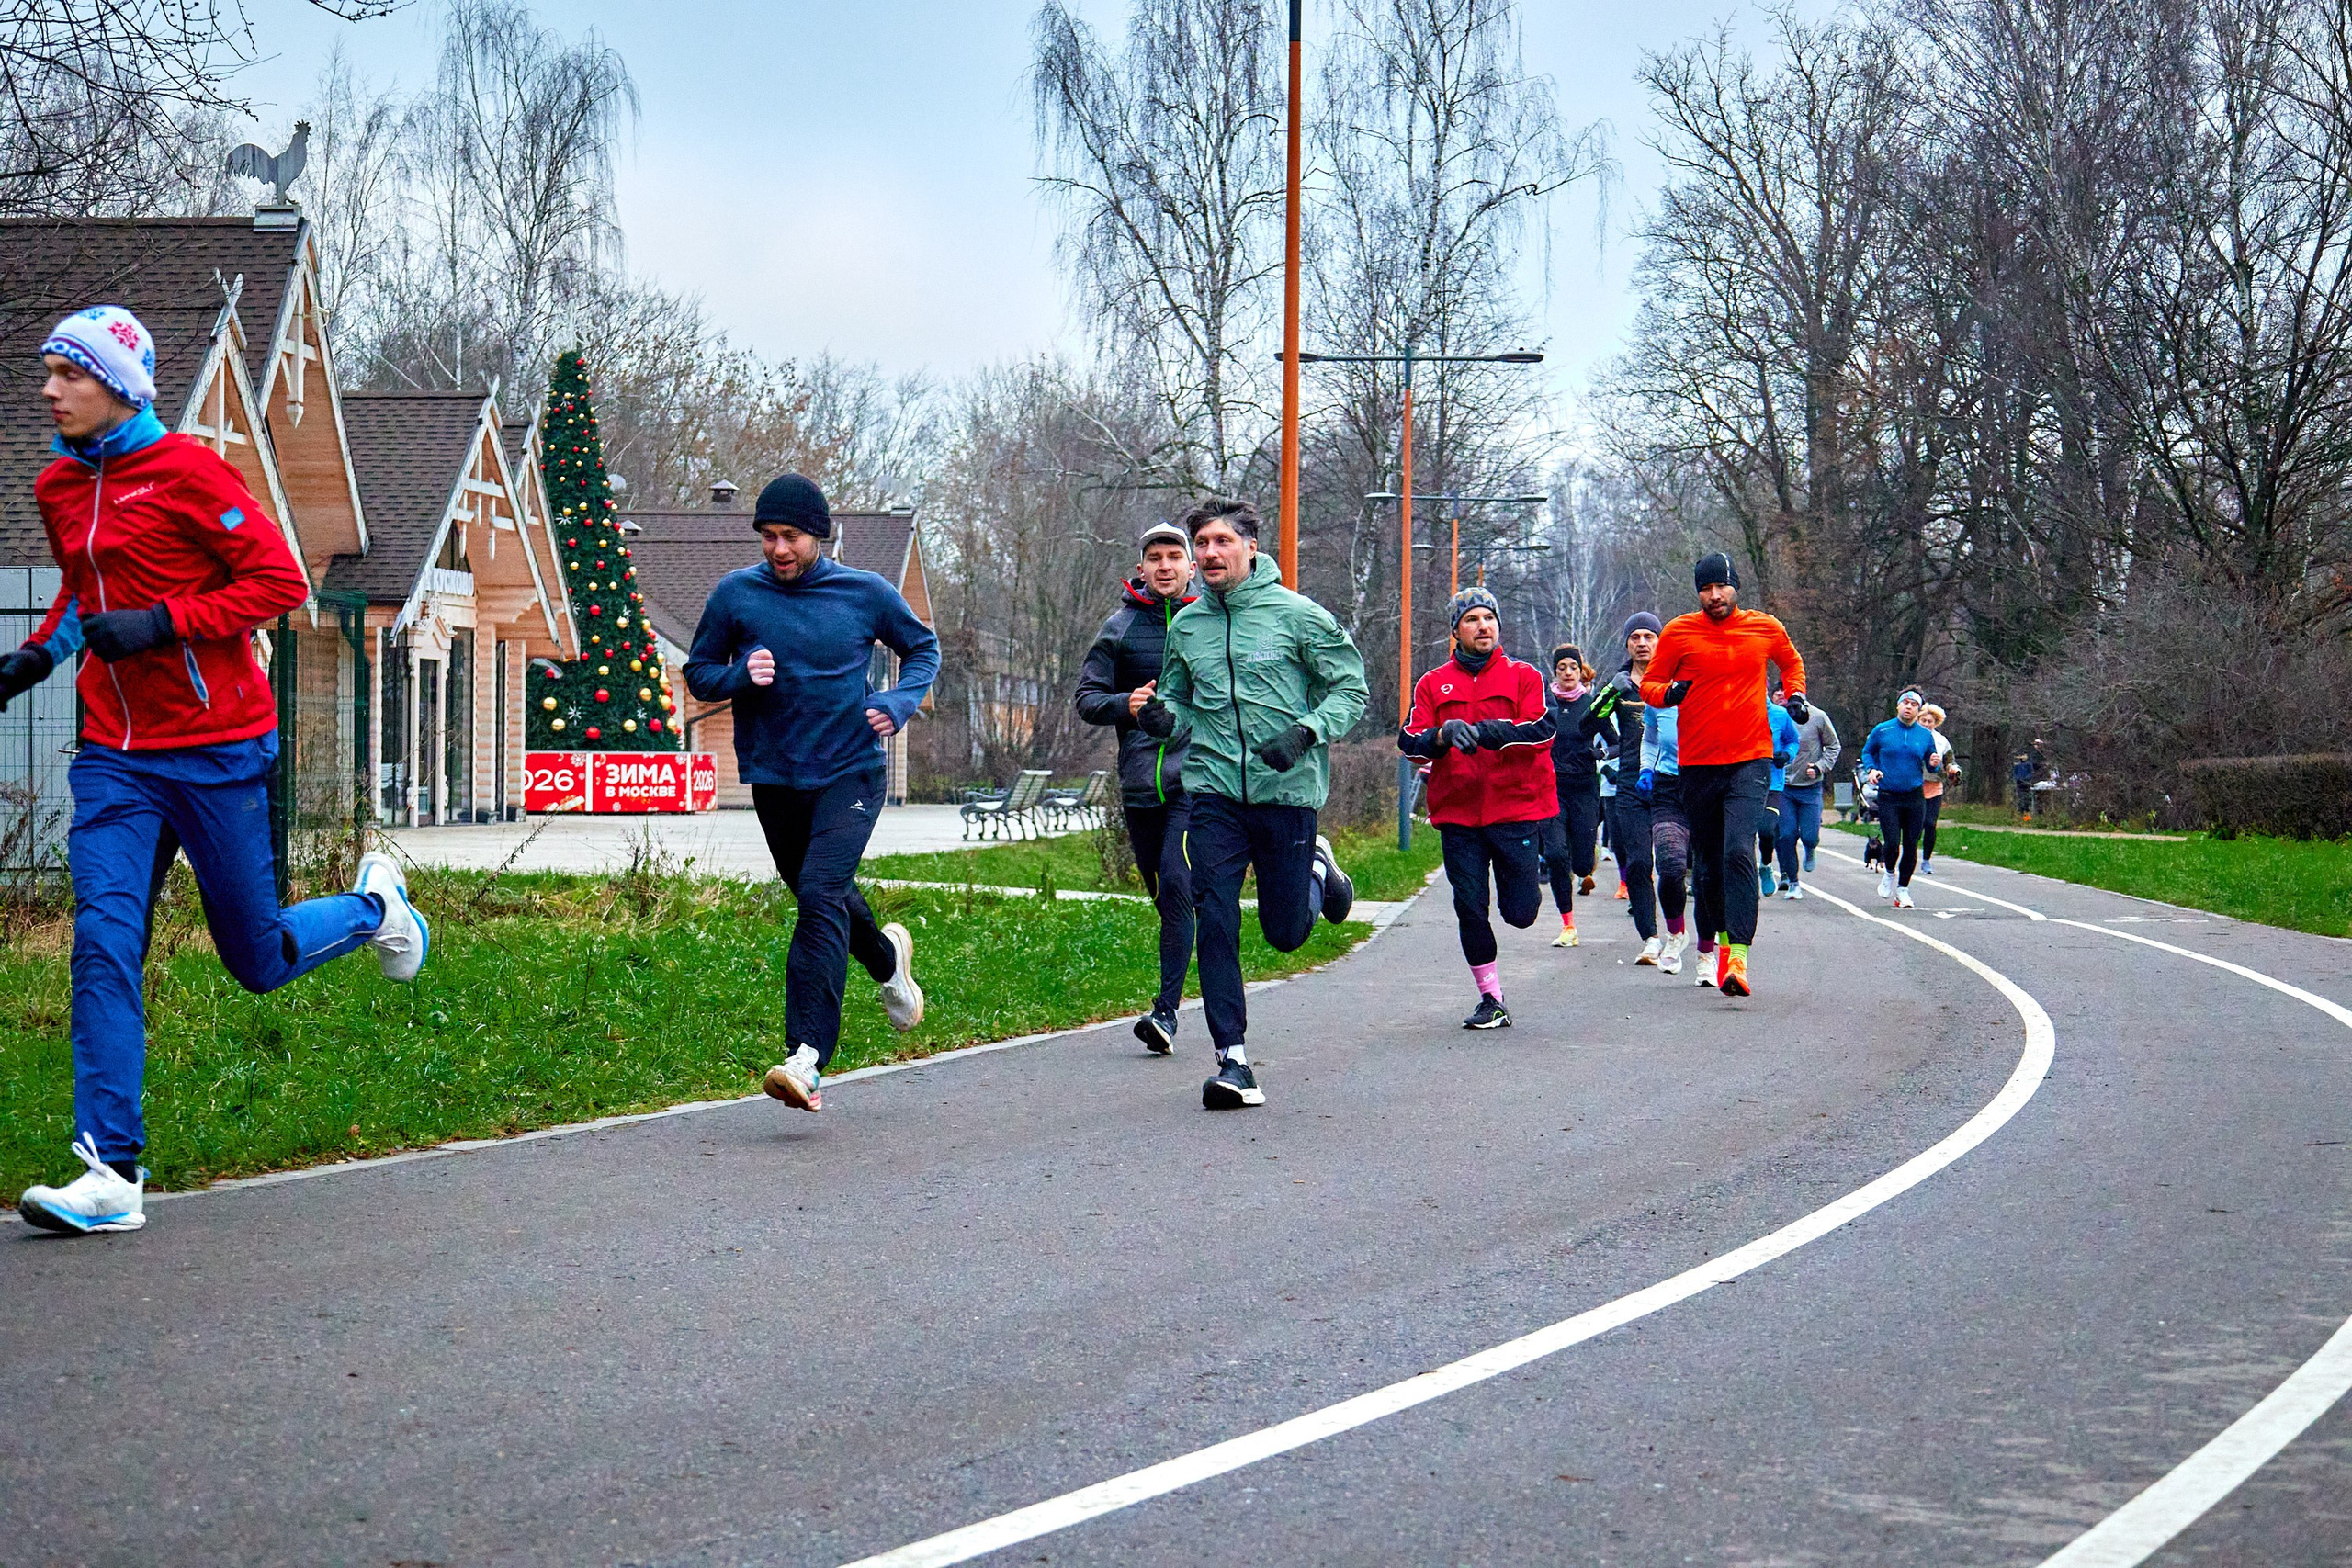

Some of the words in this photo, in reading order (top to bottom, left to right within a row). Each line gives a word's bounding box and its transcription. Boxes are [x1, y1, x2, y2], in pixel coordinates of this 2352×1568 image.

[605, 763, 676, 784] ЗИМА
[694, 770, 714, 792] 2026
[605, 786, 616, 797] В
[618, 786, 676, 797] МОСКВЕ
